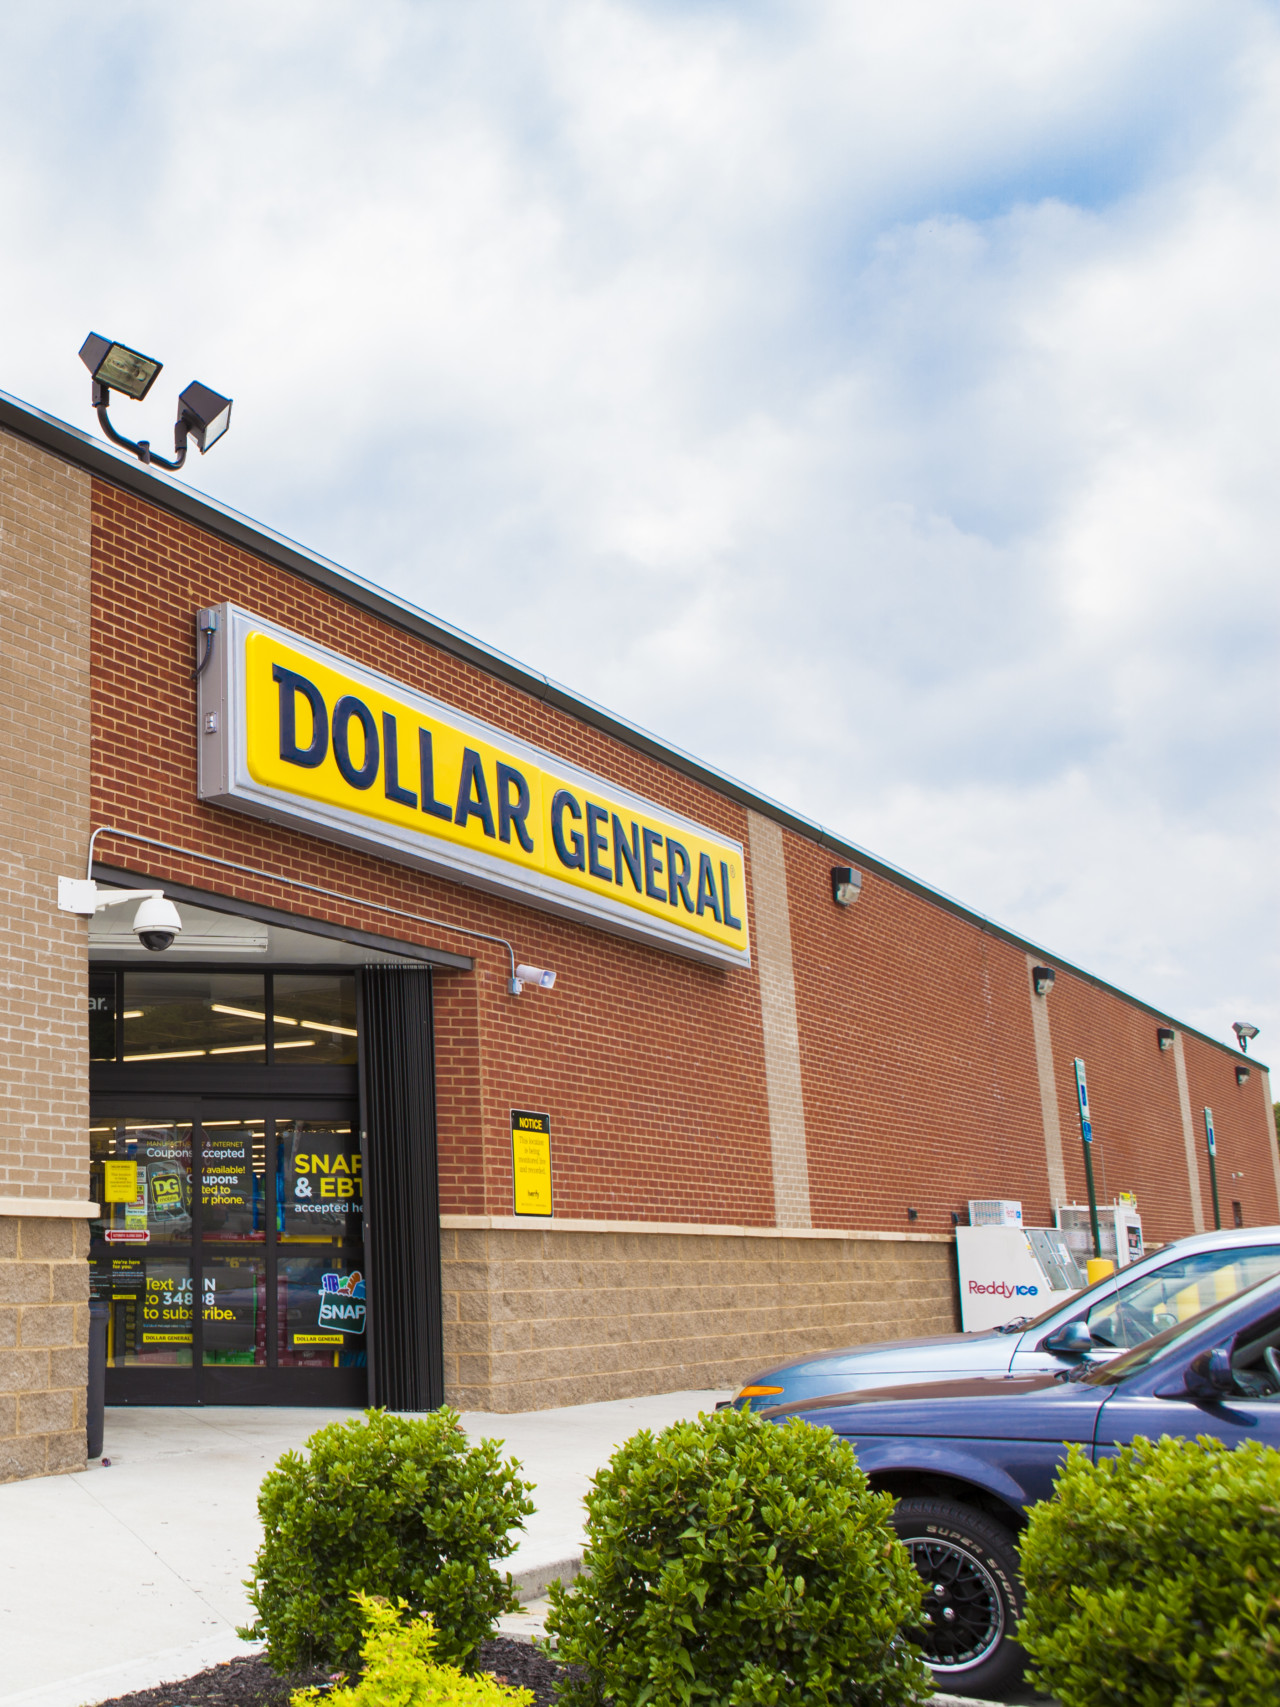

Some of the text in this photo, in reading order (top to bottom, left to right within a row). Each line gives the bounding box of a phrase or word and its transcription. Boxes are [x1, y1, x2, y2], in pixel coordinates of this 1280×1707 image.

[272, 663, 742, 930] DOLLAR GENERAL
[519, 1117, 542, 1130] NOTICE
[146, 1147, 245, 1159] Coupons ccepted
[206, 1165, 246, 1174] available!
[295, 1153, 362, 1174] SNAP
[186, 1173, 238, 1186] Cupons
[153, 1178, 179, 1196] DG
[186, 1184, 231, 1195] tted to
[295, 1177, 363, 1198] & EBT
[186, 1194, 245, 1206] yr phone.
[295, 1203, 363, 1214] accepted he
[146, 1277, 174, 1291] Text
[178, 1278, 216, 1291] JON
[969, 1281, 1015, 1298] Reddy
[146, 1292, 215, 1305] to 3488
[144, 1306, 236, 1320] to subsribe.
[321, 1304, 366, 1319] SNAP
[926, 1524, 1019, 1618] SUPER SPORT
